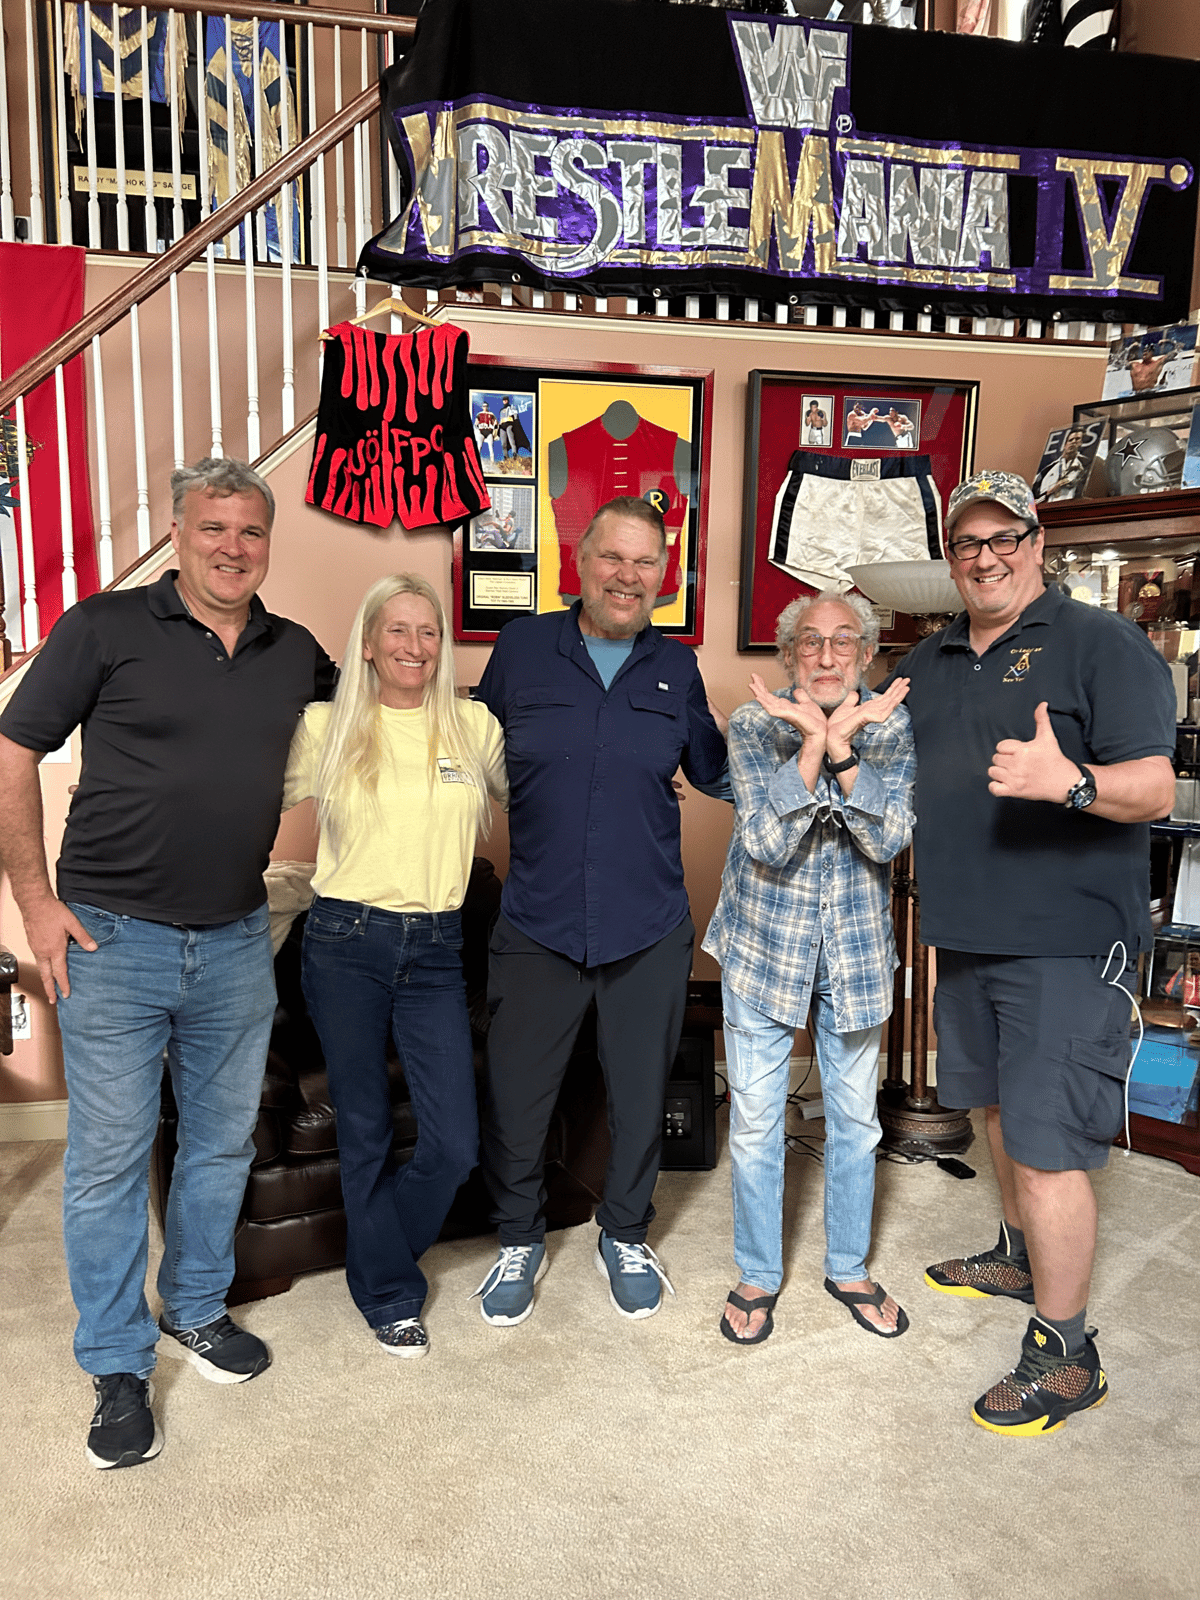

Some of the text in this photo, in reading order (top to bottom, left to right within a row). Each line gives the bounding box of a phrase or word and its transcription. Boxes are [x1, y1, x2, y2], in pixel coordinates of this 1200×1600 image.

[78, 175, 104, 184] RAY
[163, 181, 192, 191] SAGE
[852, 460, 879, 478] EVERLAST
[650, 491, 664, 513] R
